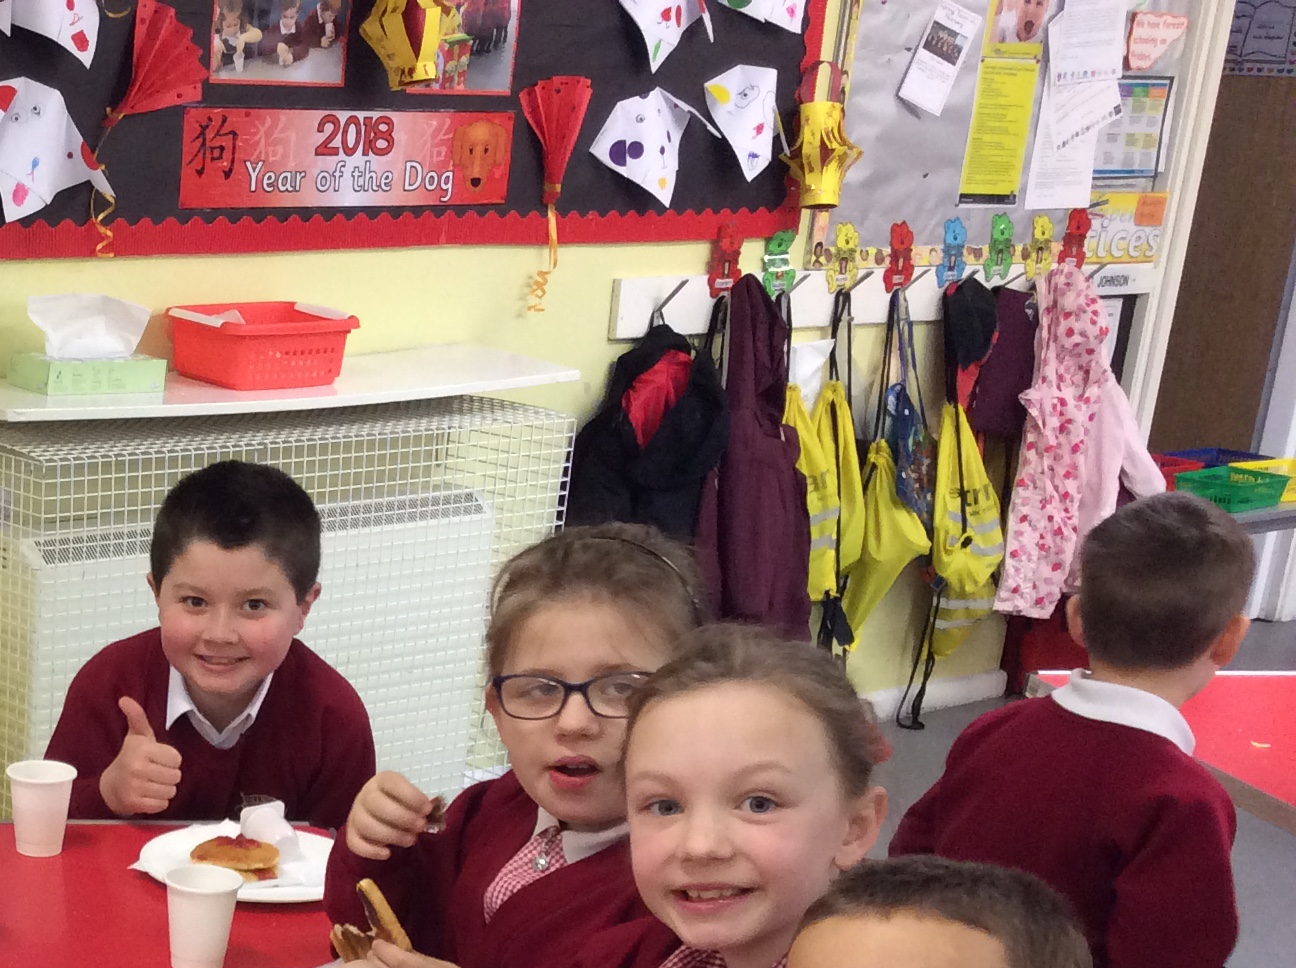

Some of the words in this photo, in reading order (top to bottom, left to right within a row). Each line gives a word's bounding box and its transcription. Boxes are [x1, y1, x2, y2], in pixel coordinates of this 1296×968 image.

[186, 113, 240, 180] 狗
[313, 113, 397, 157] 2018
[244, 160, 306, 192] Year
[315, 160, 349, 192] of
[351, 161, 393, 192] the
[403, 160, 454, 203] Dog
[1097, 274, 1129, 288] JOHNSON
